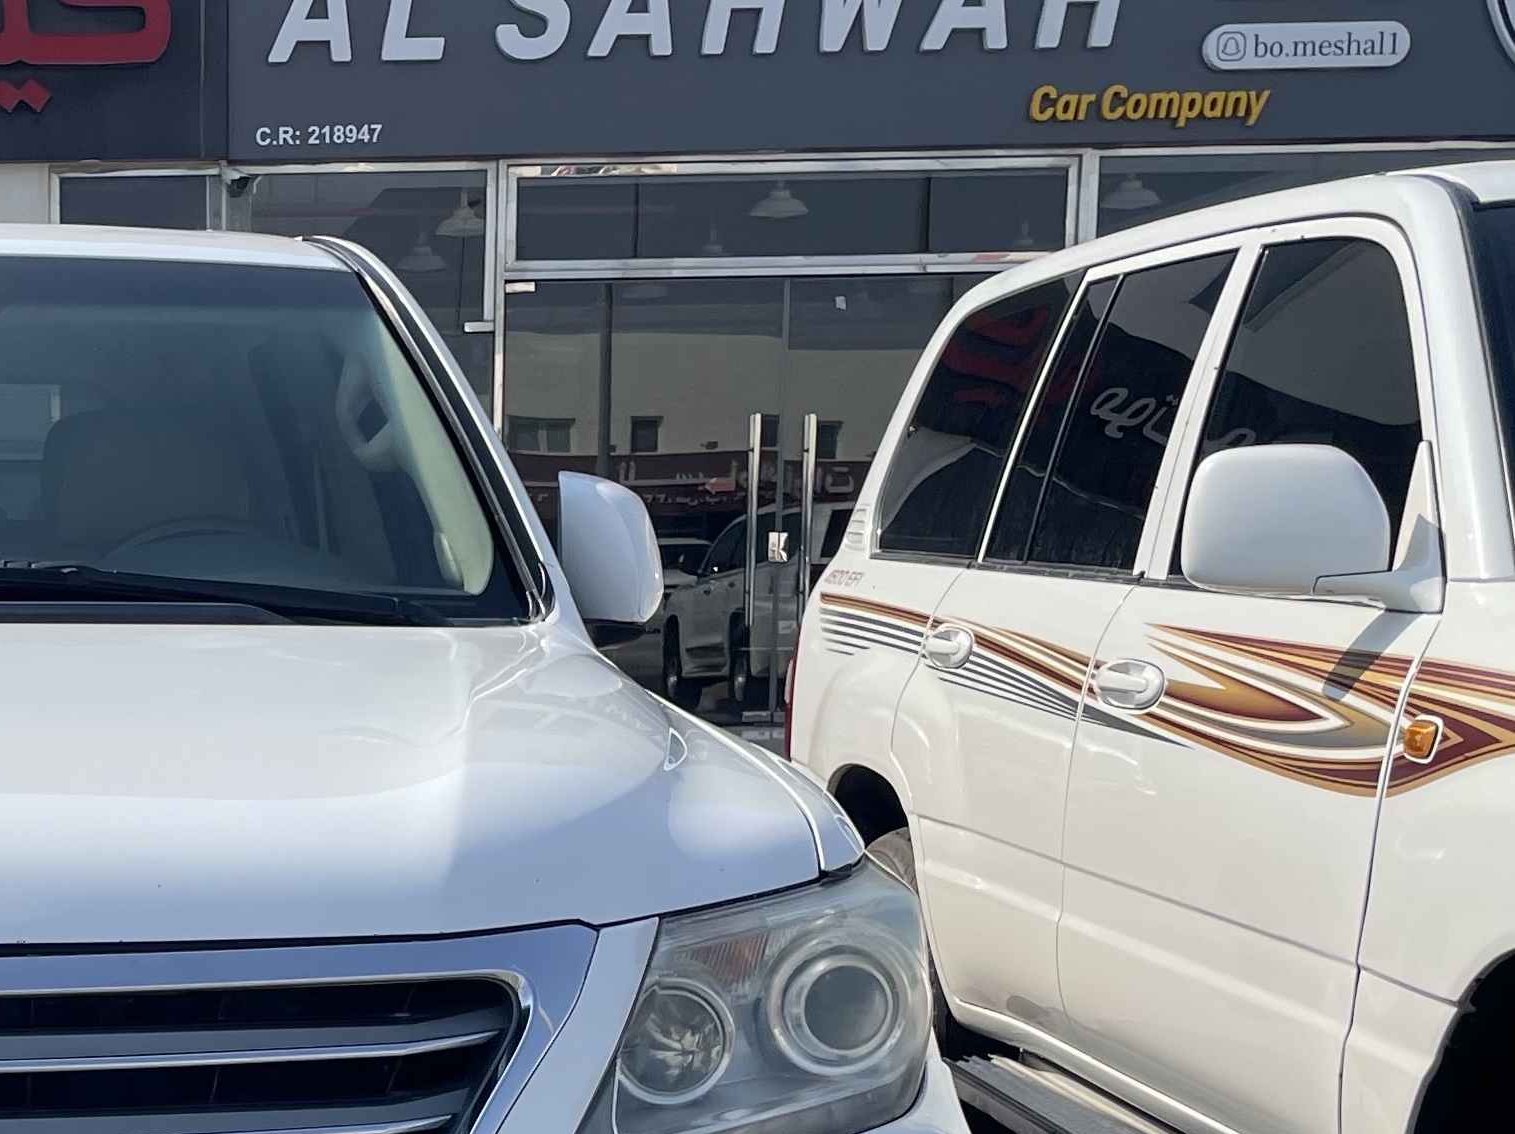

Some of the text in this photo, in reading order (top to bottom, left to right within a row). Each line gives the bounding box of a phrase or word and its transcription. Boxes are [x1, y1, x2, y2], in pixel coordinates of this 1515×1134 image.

[1029, 84, 1271, 127] Car Company
[255, 124, 383, 146] C.R: 218947
